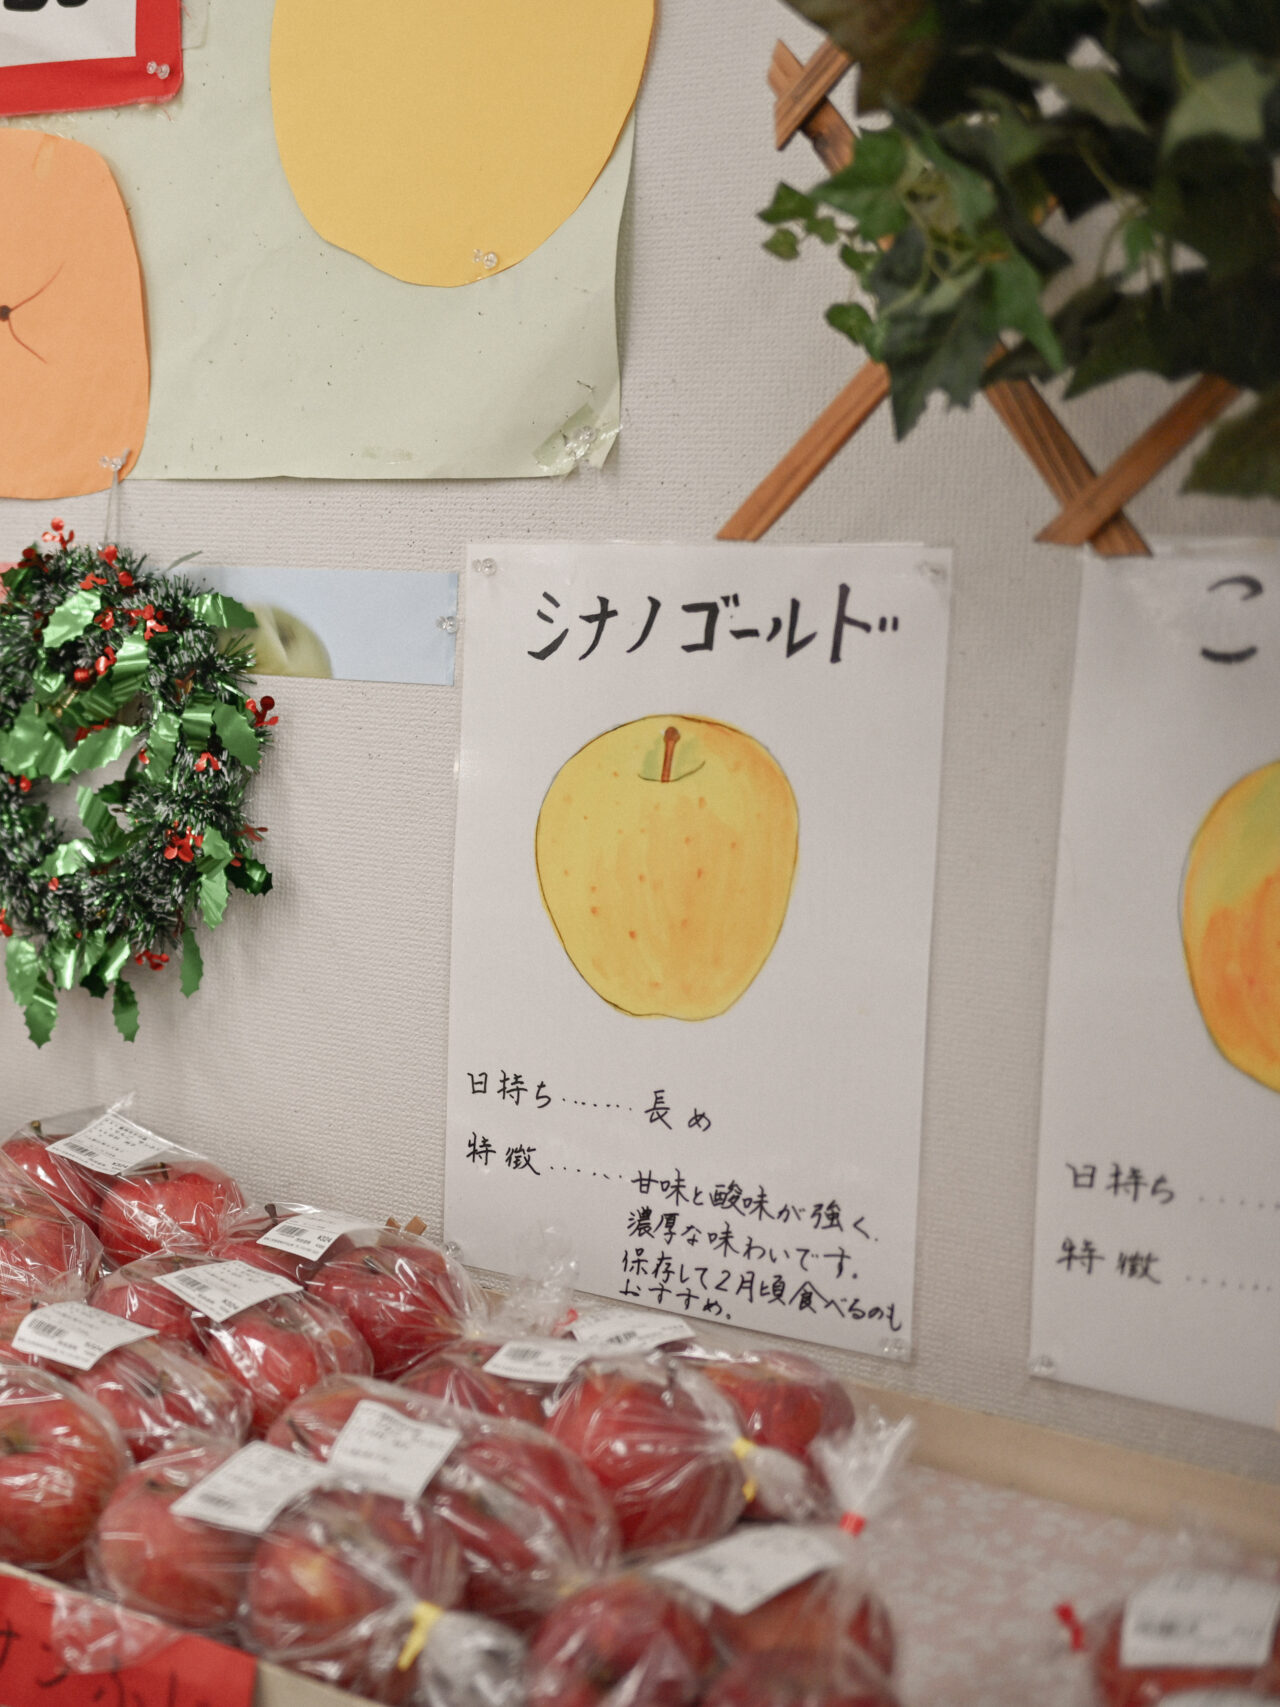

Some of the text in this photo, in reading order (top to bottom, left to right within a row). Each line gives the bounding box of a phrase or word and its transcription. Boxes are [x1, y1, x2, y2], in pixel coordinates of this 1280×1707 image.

[527, 582, 900, 664] シナノゴールド
[644, 1088, 712, 1132] 長め
[1065, 1161, 1176, 1205] 日持ち
[1056, 1236, 1163, 1286] 特徴
